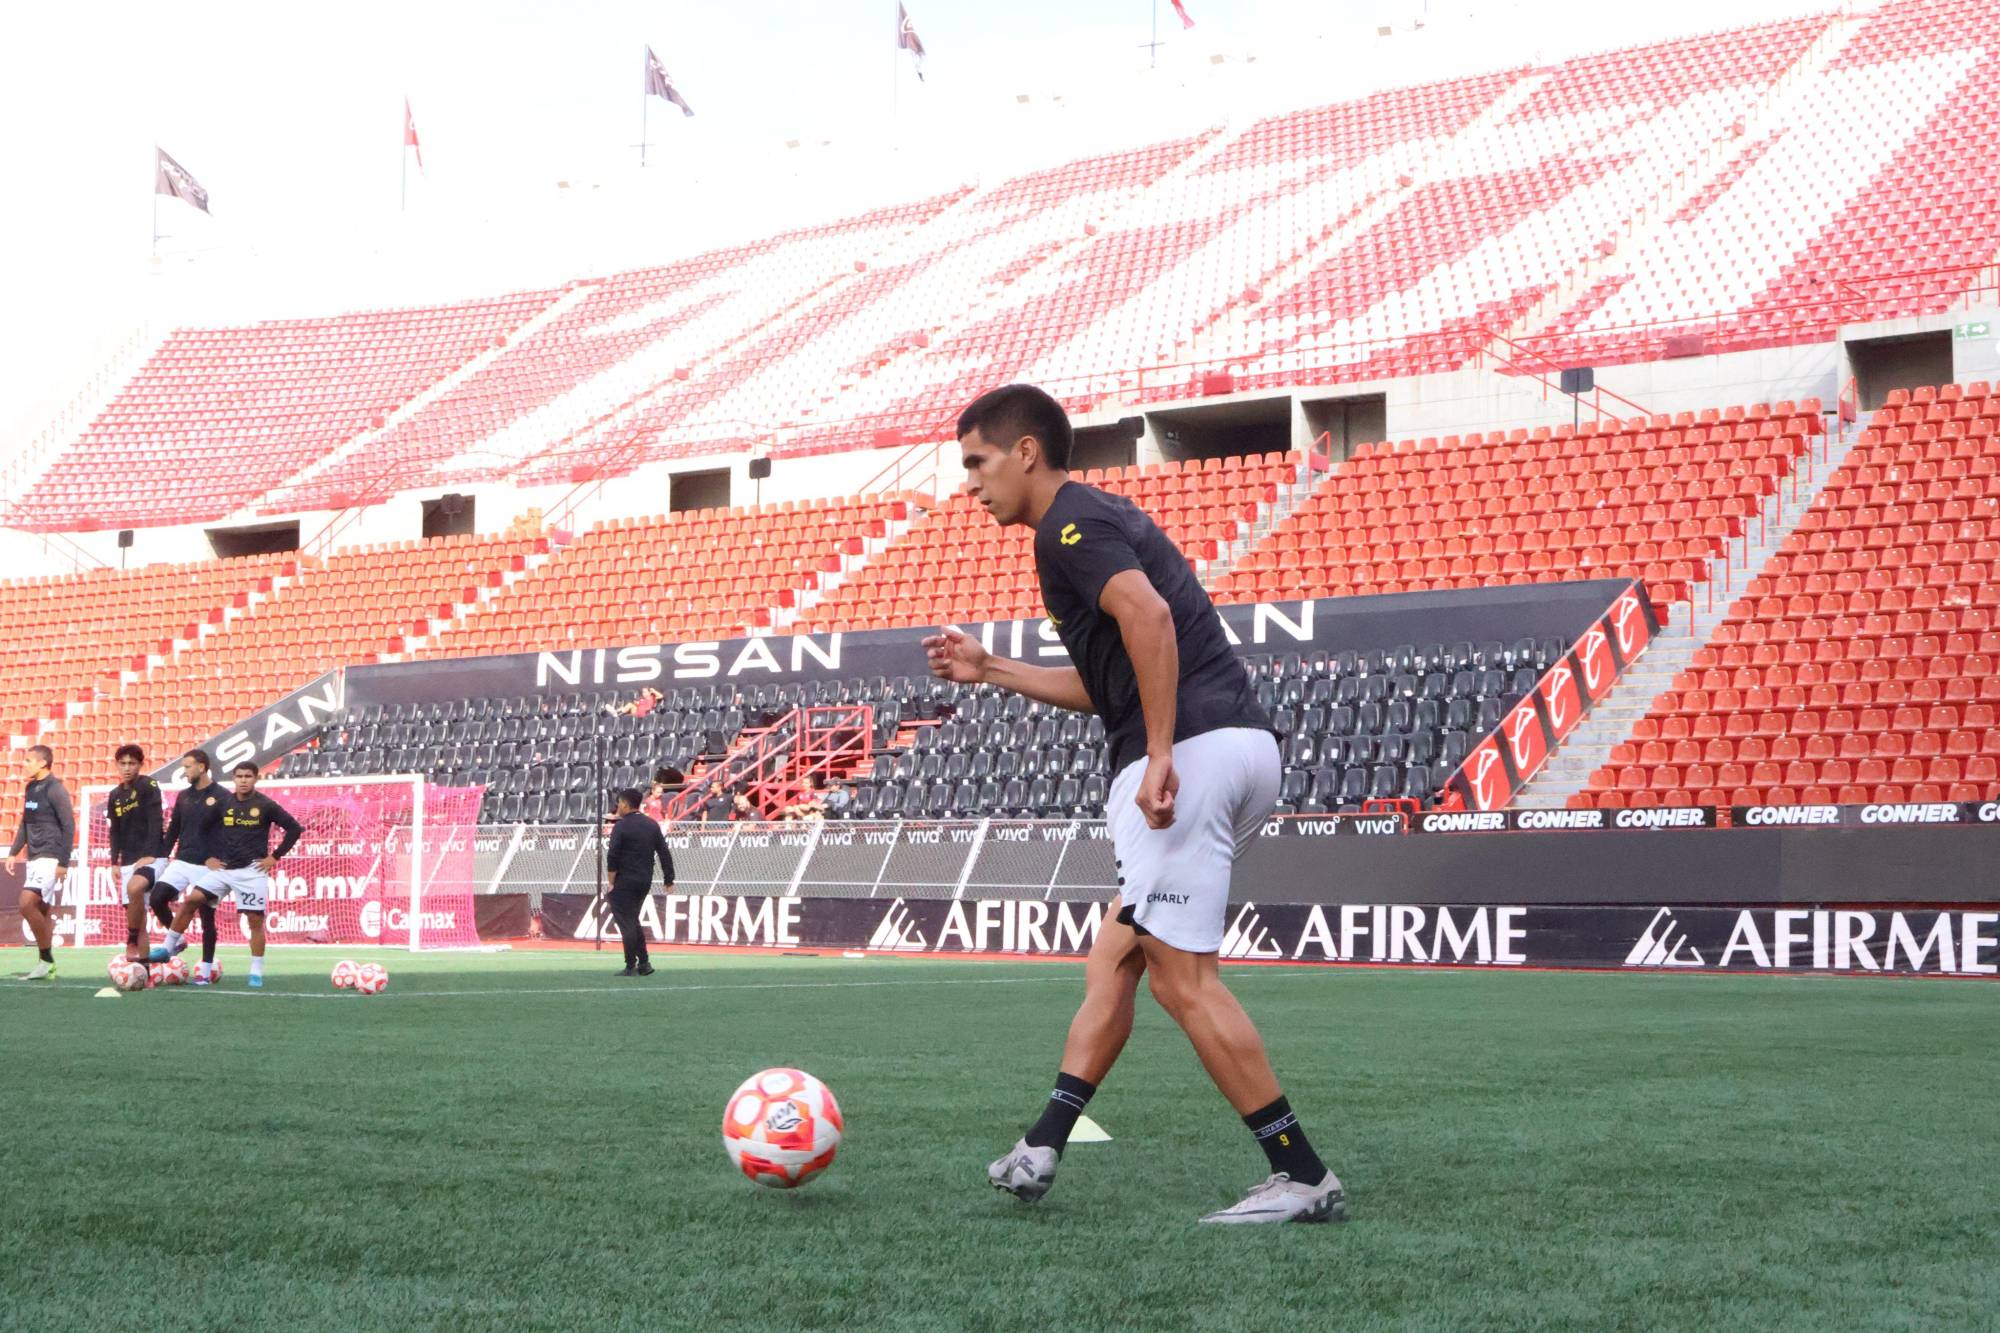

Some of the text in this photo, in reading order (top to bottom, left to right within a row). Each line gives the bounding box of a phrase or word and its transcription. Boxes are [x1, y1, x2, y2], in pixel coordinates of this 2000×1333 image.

[537, 632, 842, 686] NISSAN
[1423, 813, 1505, 832] GONHER
[1517, 810, 1603, 829] GONHER
[1616, 808, 1706, 828] GONHER
[1746, 805, 1840, 825] GONHER
[1860, 803, 1959, 823] GONHER
[907, 826, 943, 844] viva
[996, 824, 1033, 841] viva
[1297, 816, 1341, 836] viva
[1355, 815, 1399, 835] viva
[241, 892, 256, 906] 22
[1146, 892, 1190, 905] CHARLY
[266, 911, 329, 933] Calimax
[388, 908, 456, 930] Camax
[638, 894, 802, 944] AFIRME
[936, 899, 1113, 951] AFIRM
[1294, 904, 1527, 962] AFIRME
[1718, 909, 1999, 973] AFIRME
